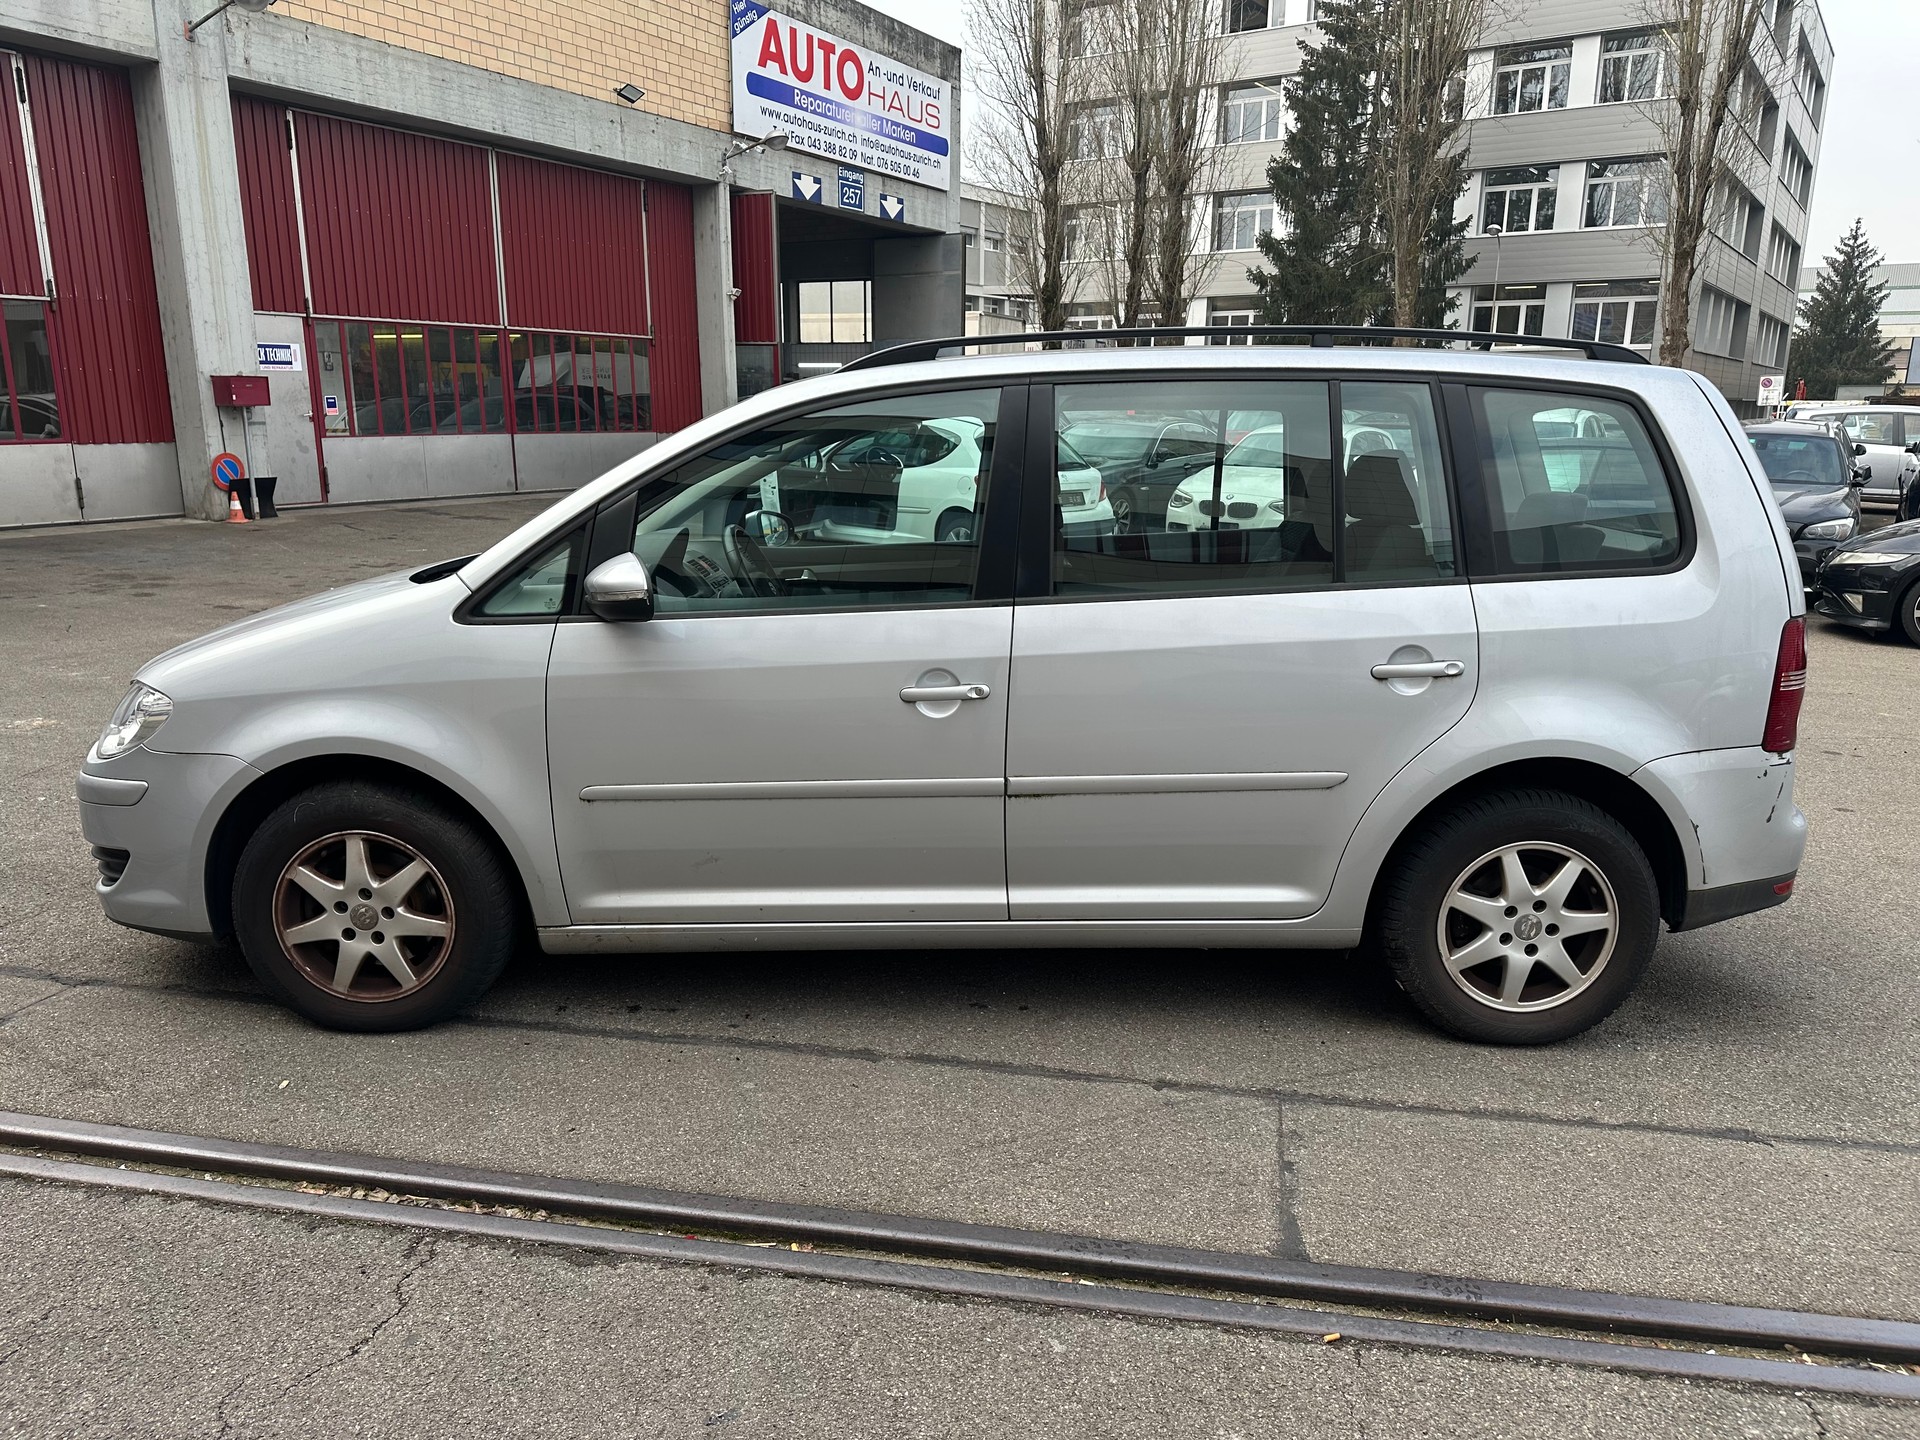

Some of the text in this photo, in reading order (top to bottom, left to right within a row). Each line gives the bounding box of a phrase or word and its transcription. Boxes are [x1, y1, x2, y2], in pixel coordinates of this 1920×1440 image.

[733, 10, 758, 34] günstig
[757, 17, 865, 101] AUTO
[867, 60, 881, 78] An
[906, 75, 941, 100] Verkauf
[868, 80, 941, 129] HAUS
[759, 105, 942, 170] www.autohaus-zurich.ch info@autohaus-zurich.ch
[858, 111, 881, 132] aller
[882, 119, 916, 144] Marken
[807, 135, 821, 151] 043
[823, 140, 837, 155] 388
[838, 145, 848, 158] 82
[848, 148, 858, 161] 09
[860, 151, 876, 167] Nat.
[876, 156, 889, 170] 076
[889, 160, 902, 174] 505
[902, 163, 911, 177] 00
[911, 166, 921, 179] 46
[838, 166, 864, 184] Eingang
[842, 186, 861, 205] 257
[265, 347, 292, 362] TECHNIK
